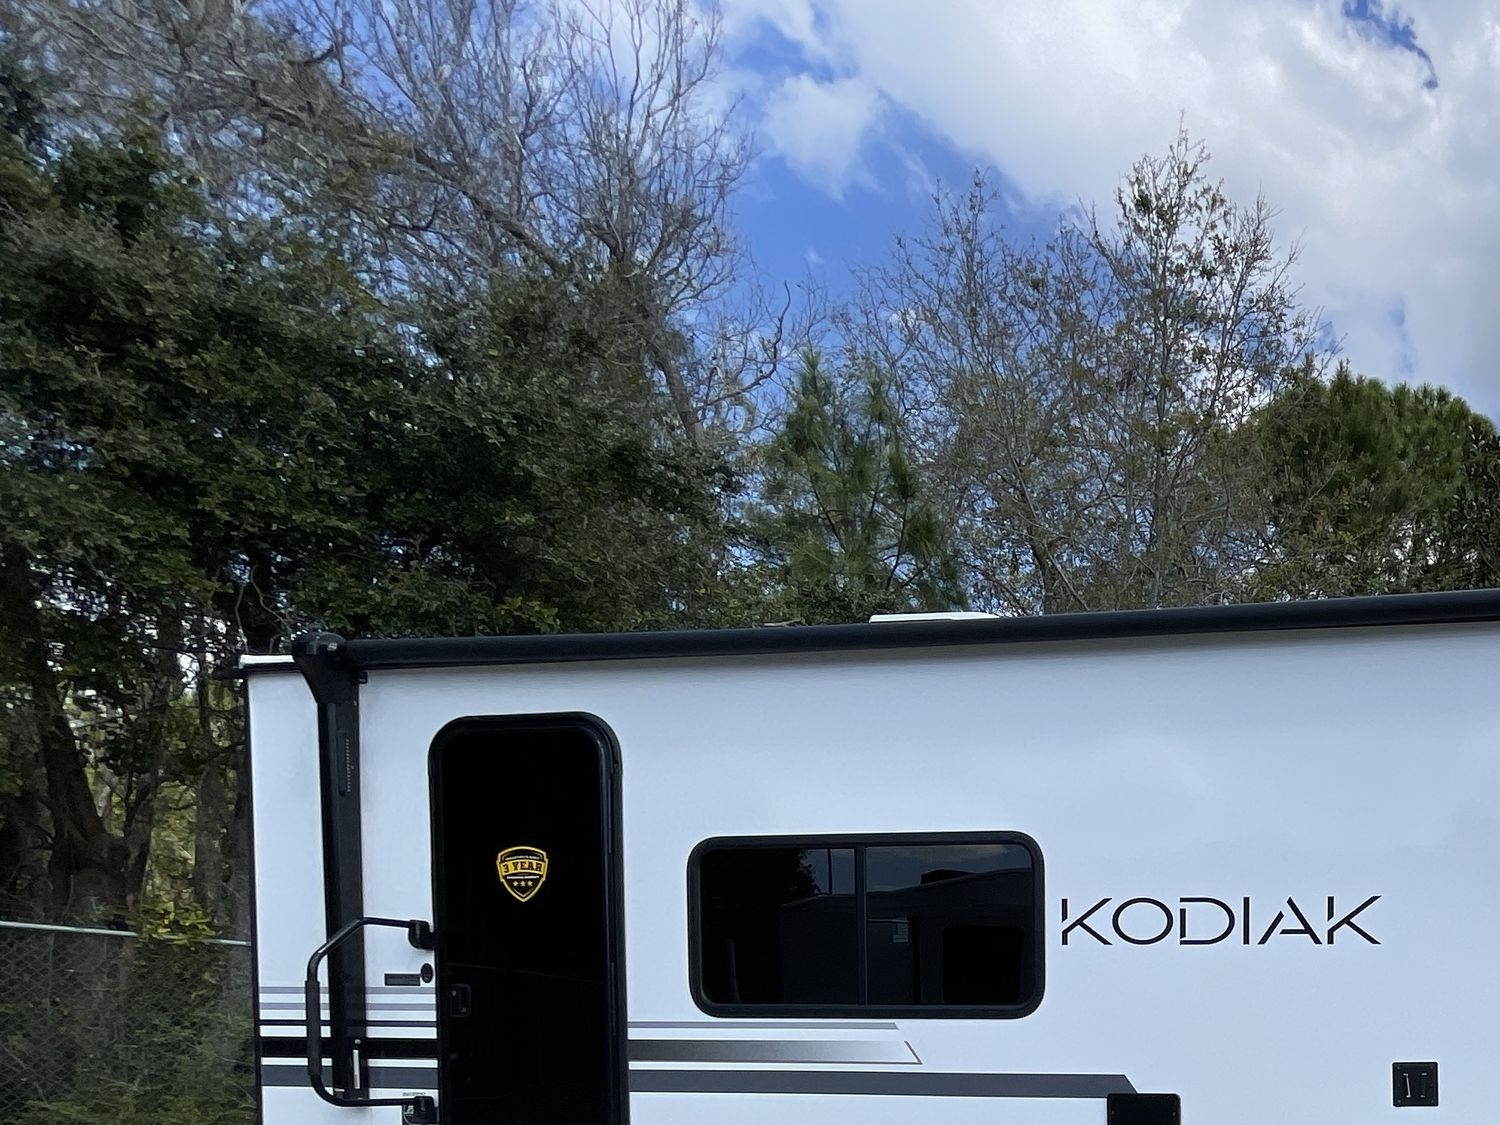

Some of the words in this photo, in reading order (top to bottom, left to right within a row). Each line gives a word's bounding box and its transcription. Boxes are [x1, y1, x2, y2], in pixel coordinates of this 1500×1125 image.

[503, 864, 510, 873] 3
[512, 861, 543, 873] YEAR
[1061, 895, 1382, 945] KODIAK
